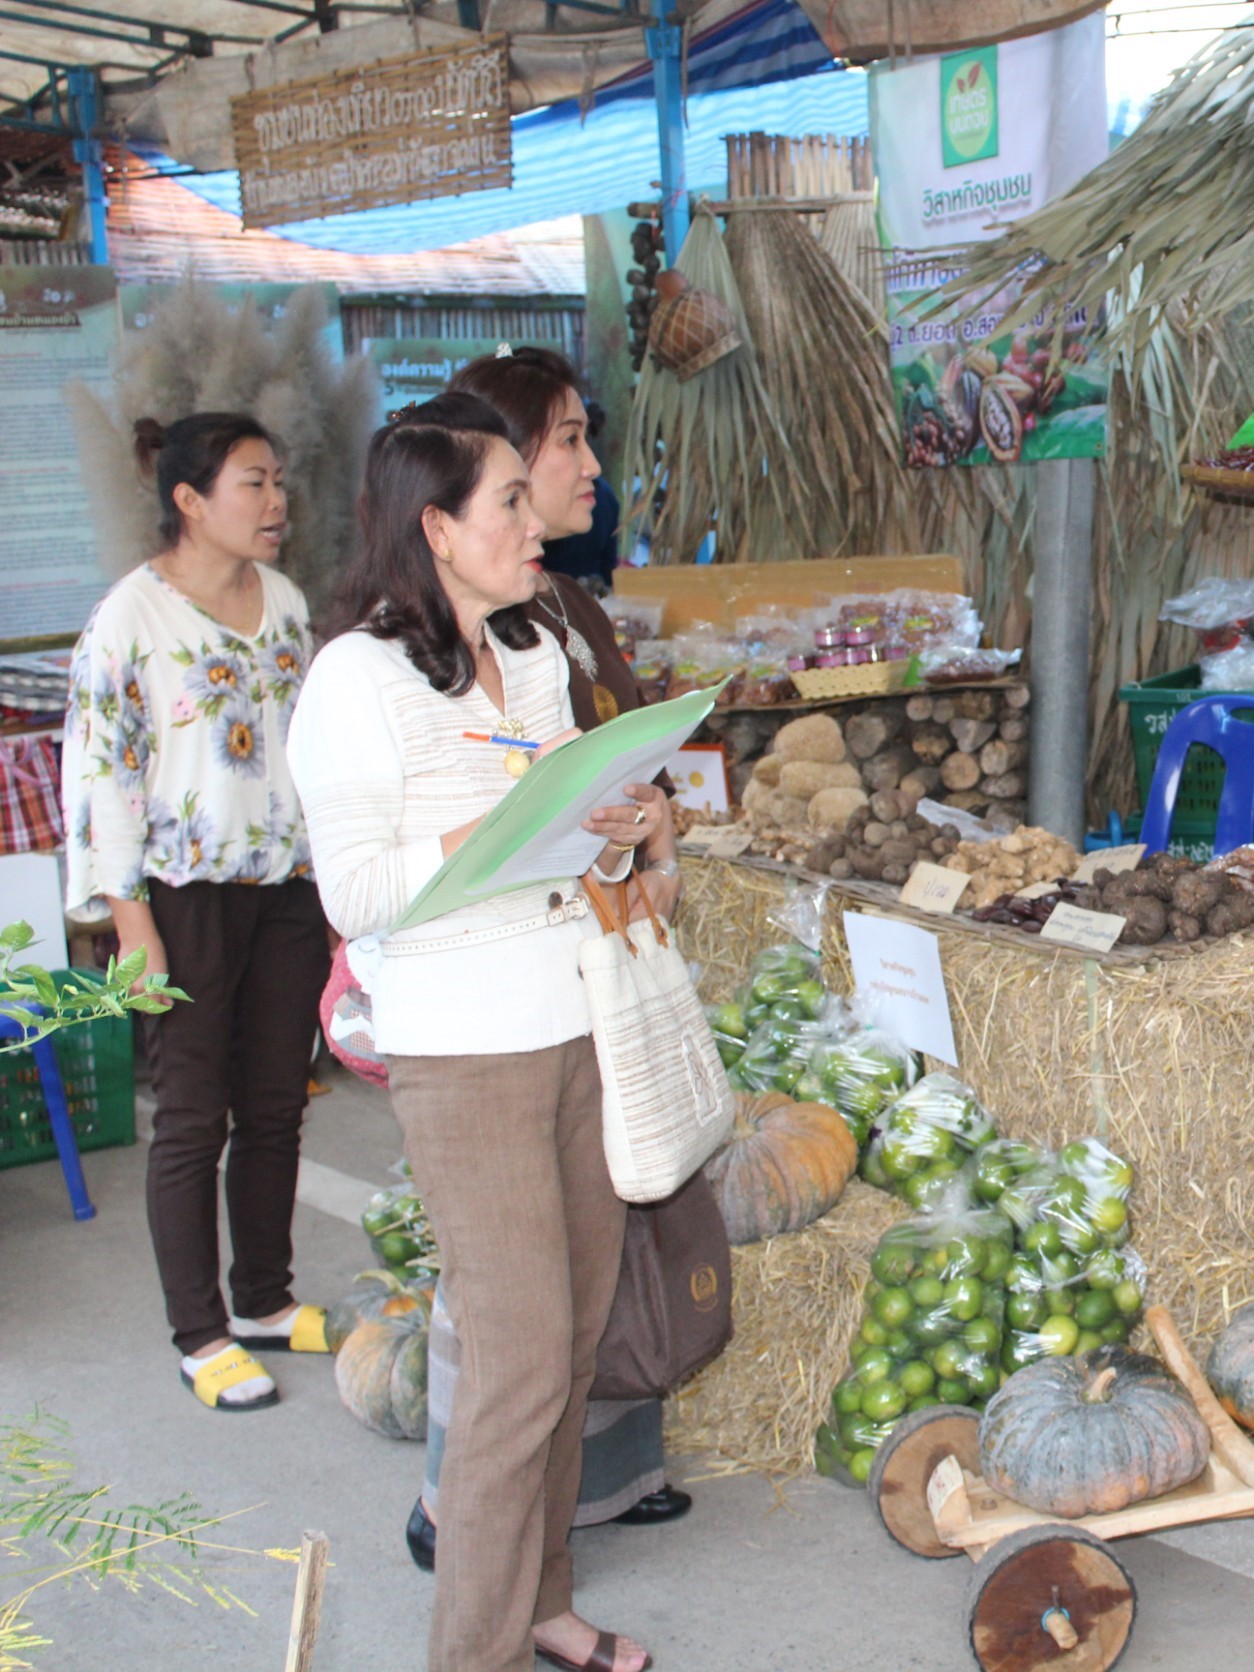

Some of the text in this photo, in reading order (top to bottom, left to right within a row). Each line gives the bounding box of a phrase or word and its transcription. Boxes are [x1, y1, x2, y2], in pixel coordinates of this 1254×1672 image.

[922, 173, 1032, 218] วิสาหกิจชุมชน
